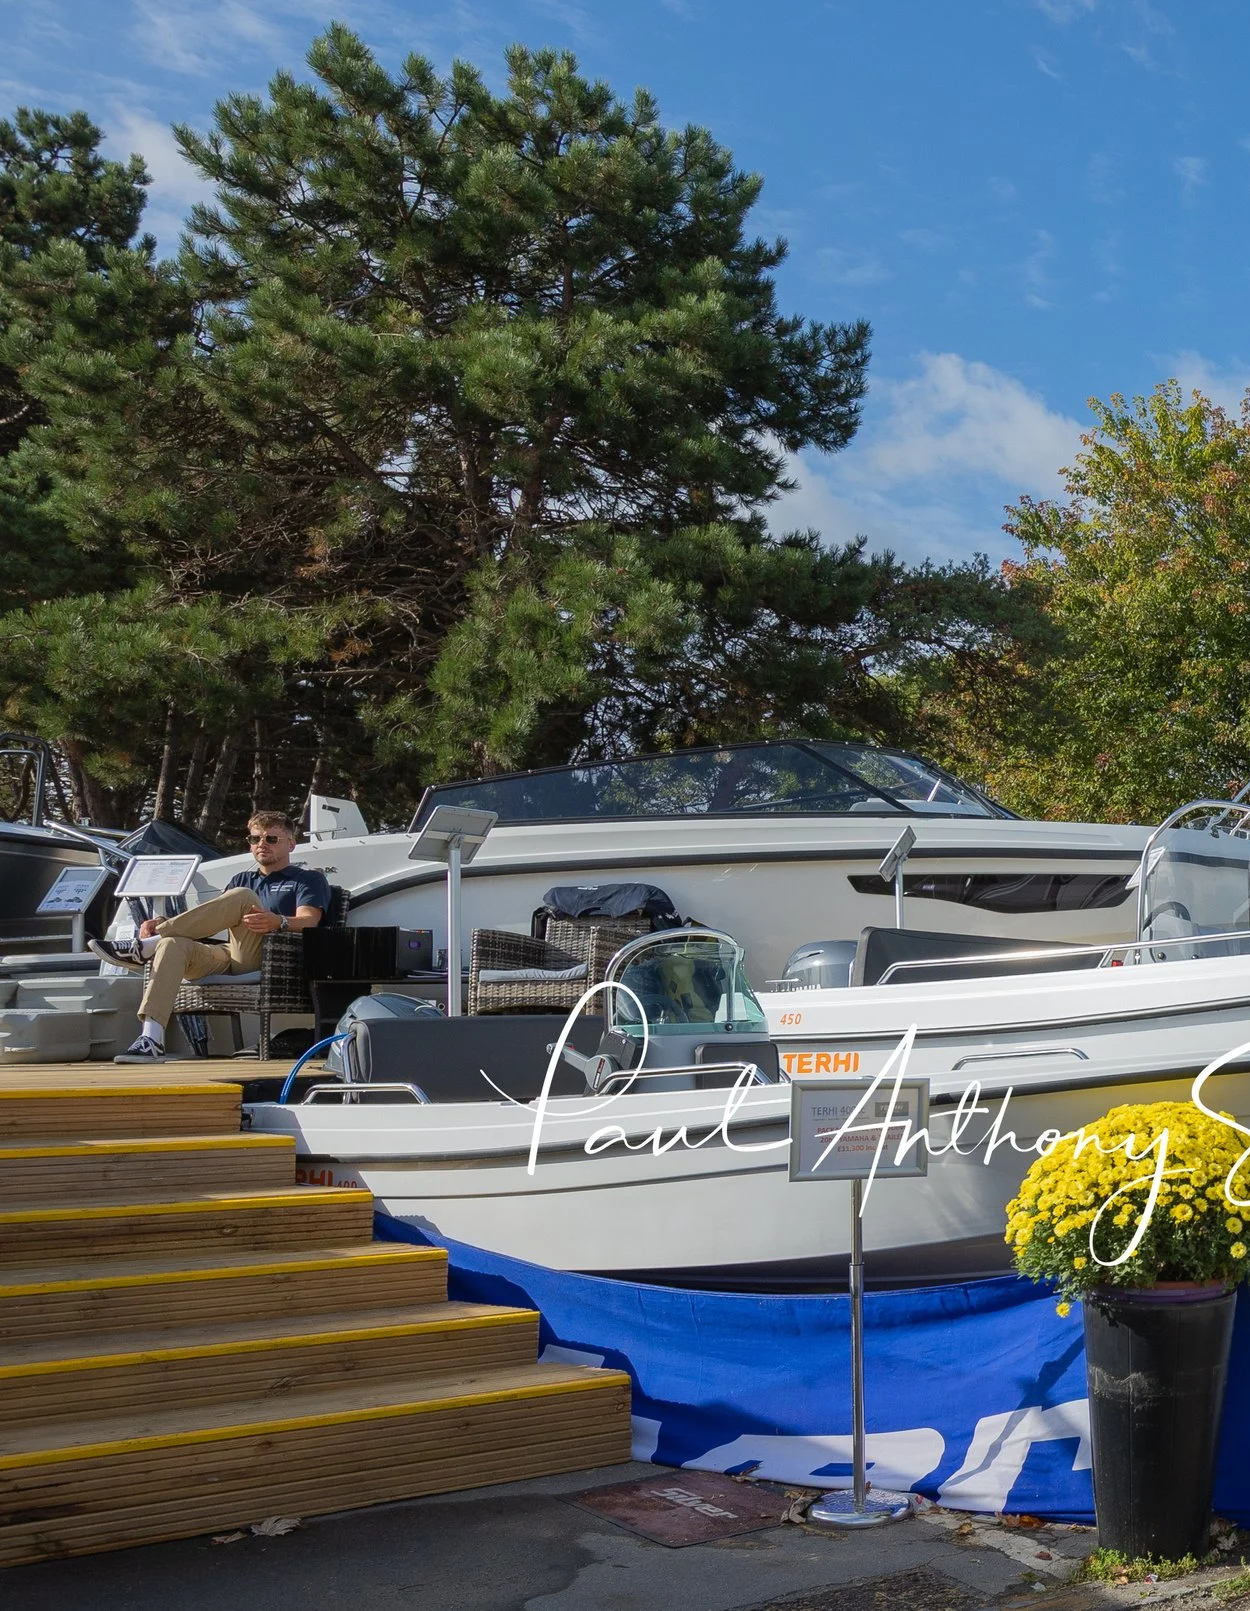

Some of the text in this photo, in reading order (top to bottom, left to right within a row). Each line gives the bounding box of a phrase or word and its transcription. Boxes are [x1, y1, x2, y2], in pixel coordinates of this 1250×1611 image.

[780, 1013, 802, 1025] 450
[782, 1051, 860, 1074] TERHI
[811, 1106, 838, 1116] TERHI
[880, 1104, 904, 1112] TEHI
[650, 1487, 739, 1519] Silver
